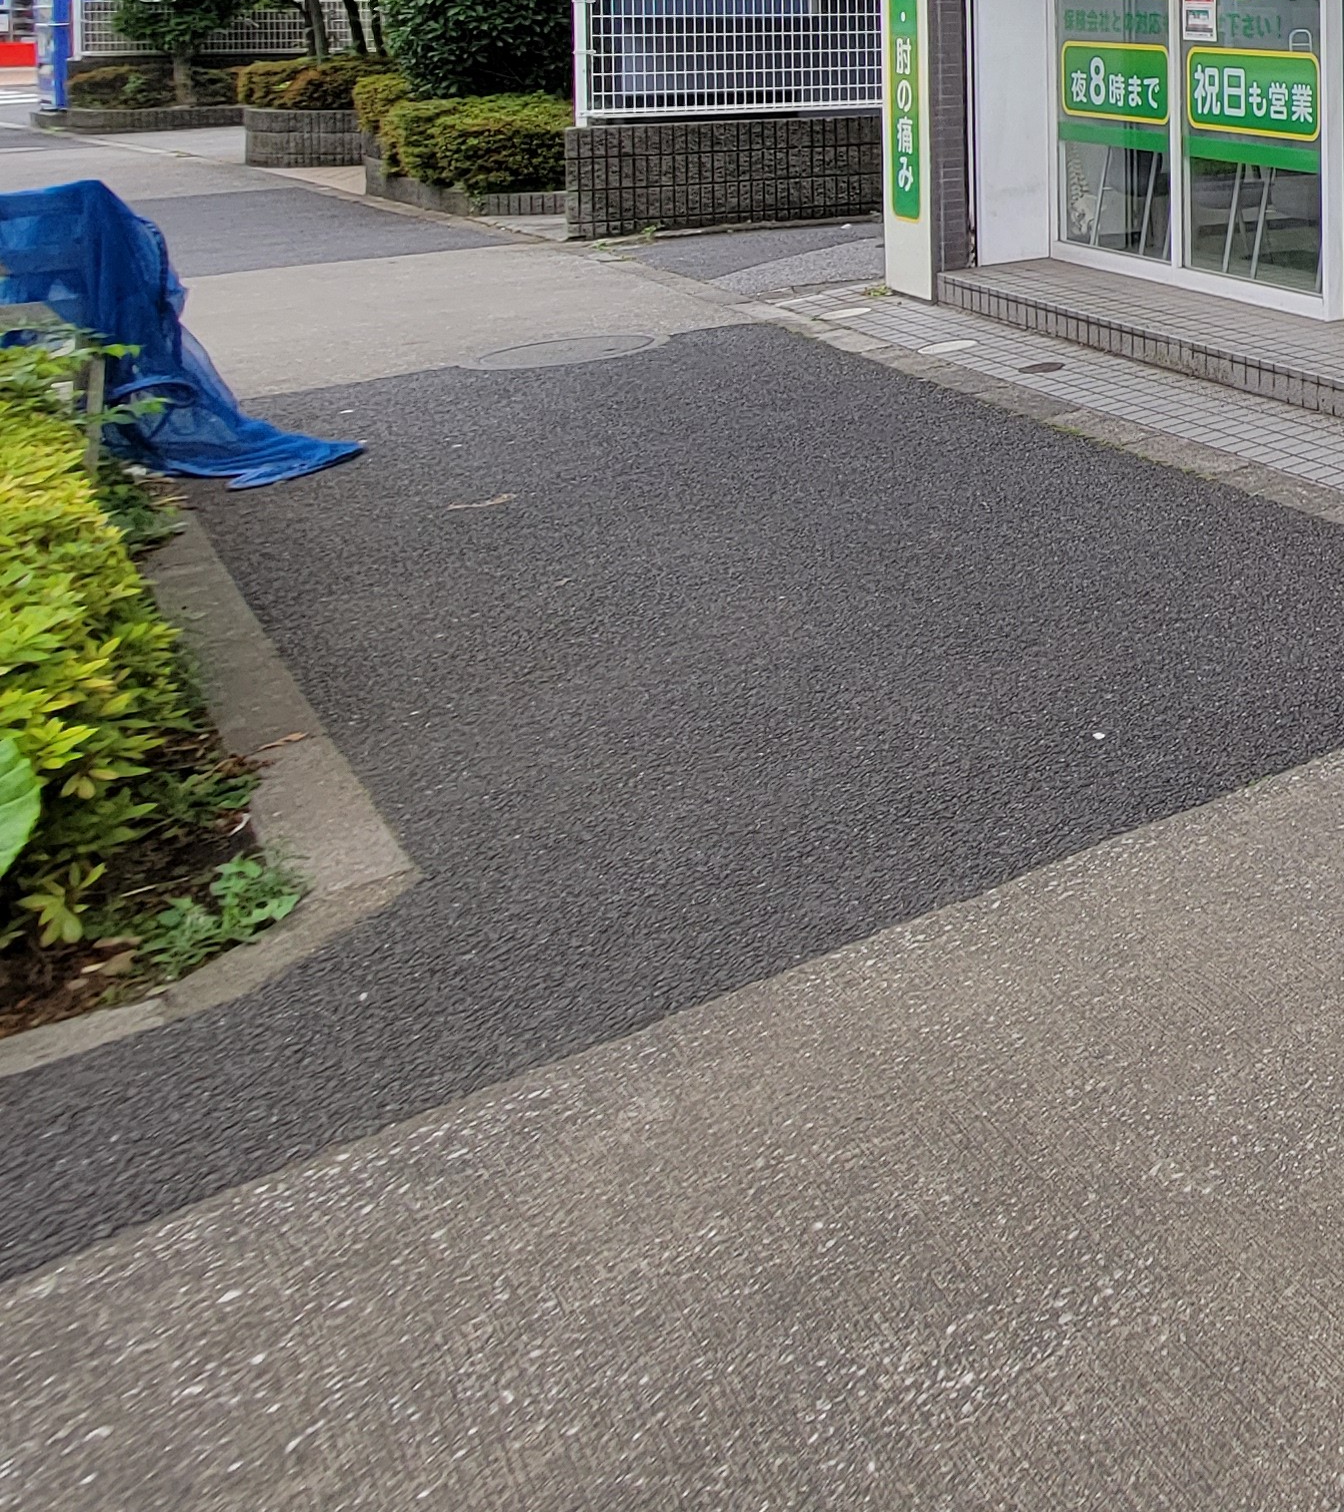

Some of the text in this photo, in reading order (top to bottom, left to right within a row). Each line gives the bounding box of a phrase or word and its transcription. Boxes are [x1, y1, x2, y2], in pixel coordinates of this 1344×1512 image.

[1071, 56, 1160, 109] 夜8時まで
[1194, 64, 1313, 124] 祝日も営業
